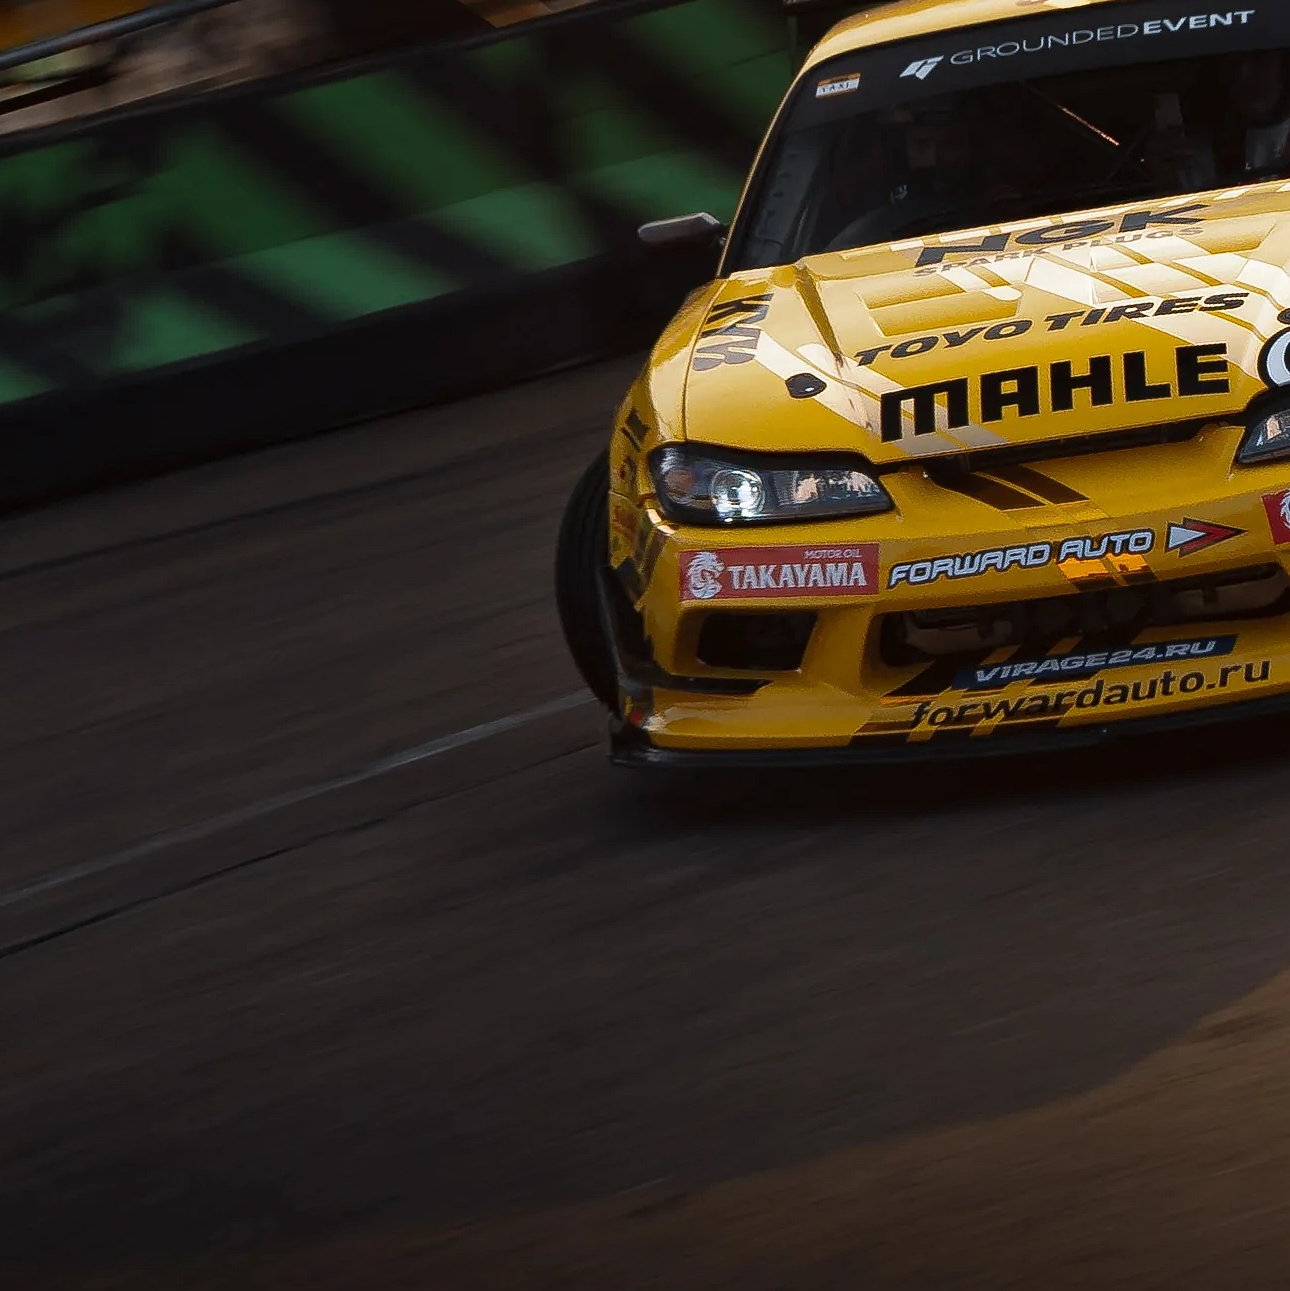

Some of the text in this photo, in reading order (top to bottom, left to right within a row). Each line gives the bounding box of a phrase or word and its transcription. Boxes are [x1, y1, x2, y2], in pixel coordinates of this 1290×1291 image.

[912, 225, 1205, 278] SPARK PLUGS
[914, 204, 1210, 268] NGK
[854, 292, 1250, 368] TOYO TIRES
[880, 342, 1231, 445] MAHLE
[727, 562, 868, 590] TAKAYAMA
[804, 548, 862, 560] MOTOR OIL
[887, 530, 1154, 588] FORWARD AUTO
[976, 639, 1217, 683] VIRAGE24.RU
[910, 659, 1273, 729] forwardauto.ru
